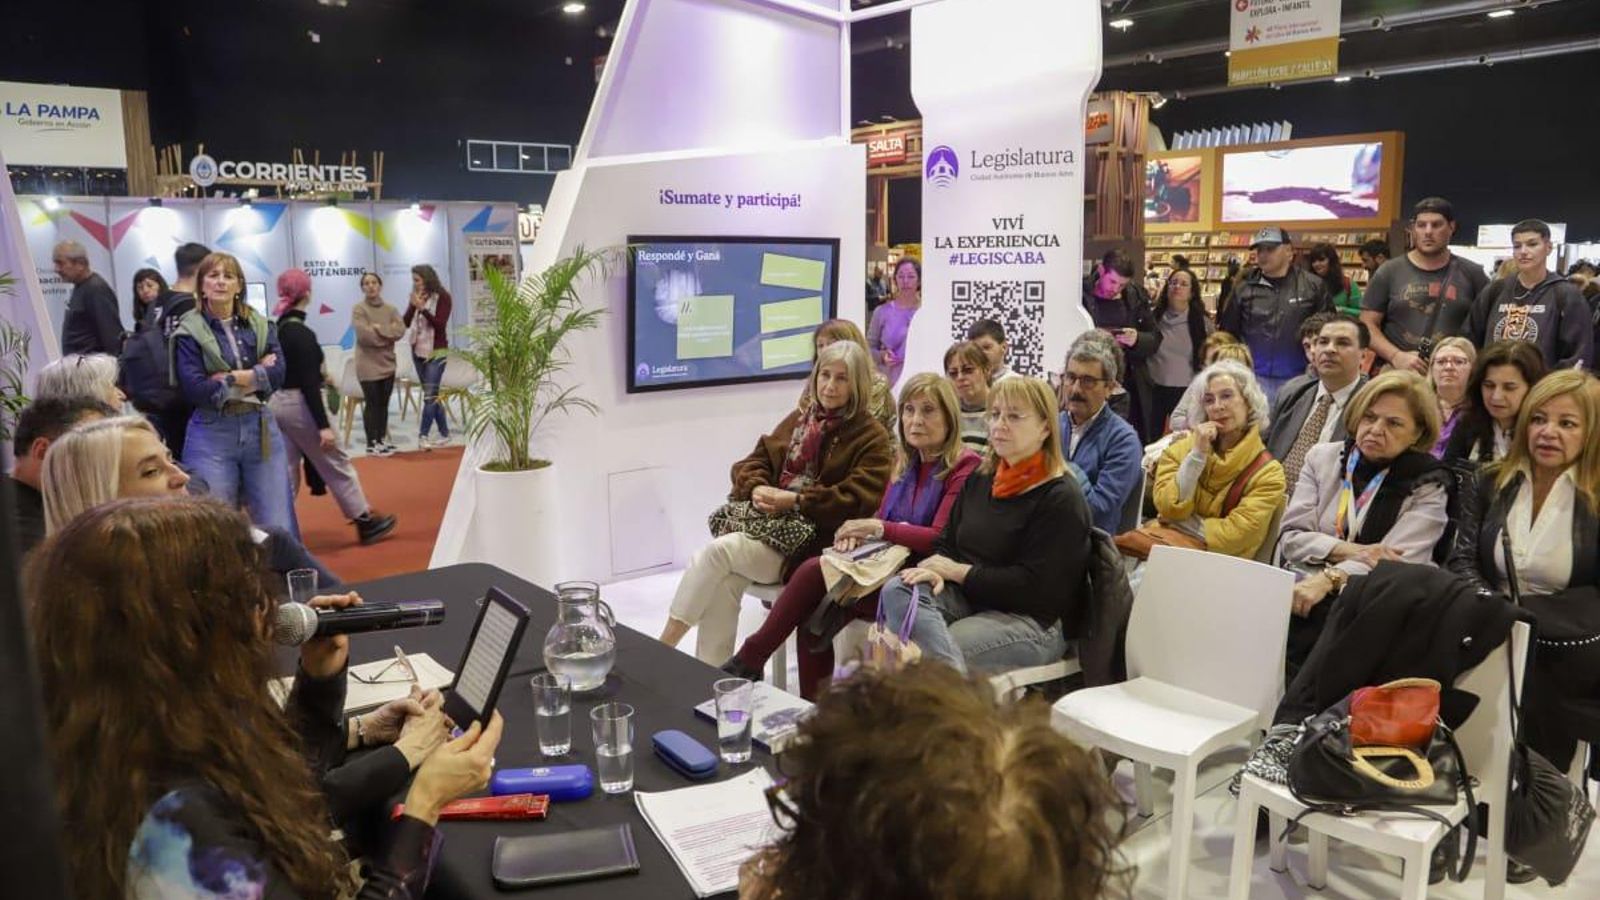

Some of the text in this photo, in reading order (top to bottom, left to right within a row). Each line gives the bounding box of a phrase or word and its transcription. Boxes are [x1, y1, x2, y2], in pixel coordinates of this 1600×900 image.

[1282, 1, 1311, 12] INFANTIL
[6, 102, 100, 120] LA PAMPA
[869, 138, 903, 153] SALTA
[970, 147, 1074, 171] Legislatura
[219, 161, 367, 182] CORRIENTES
[659, 189, 801, 210] ¡Sumate y participá!
[991, 214, 1024, 231] VIVÍ
[934, 233, 1060, 249] LA EXPERIENCIA
[303, 260, 340, 268] ESTO ES
[638, 249, 686, 263] Respondé
[687, 252, 694, 263] y
[948, 251, 1046, 266] #LEGISCABA
